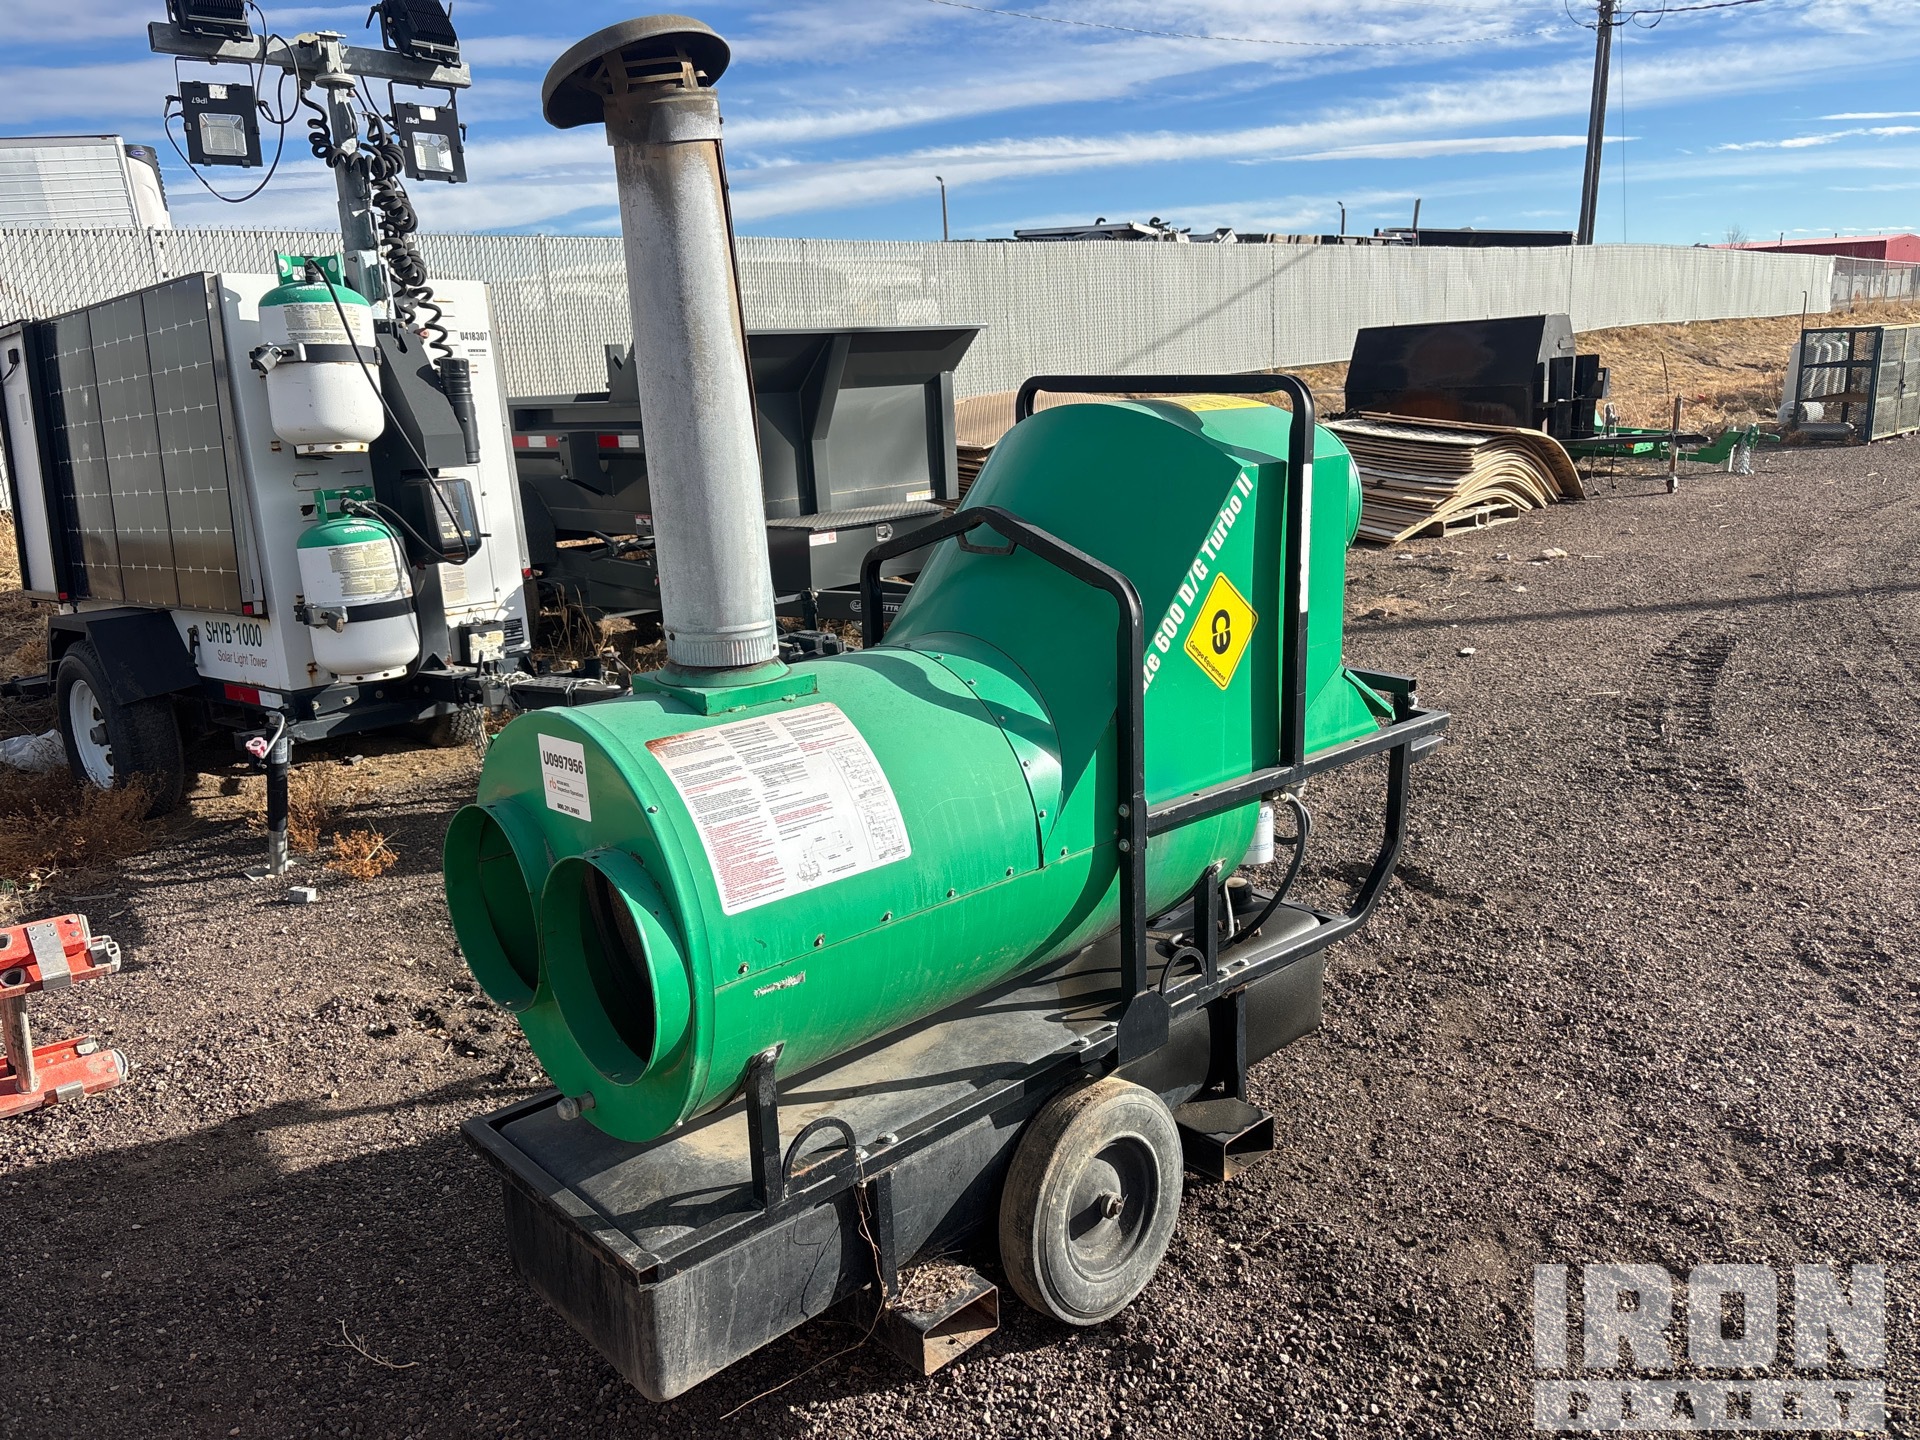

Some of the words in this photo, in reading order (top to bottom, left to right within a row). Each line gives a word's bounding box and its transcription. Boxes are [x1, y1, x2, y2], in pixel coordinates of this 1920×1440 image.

[191, 96, 208, 104] IP67
[405, 116, 420, 125] IP67
[1154, 602, 1185, 653] 600
[1178, 558, 1209, 607] D/G
[1200, 494, 1243, 561] Turbo
[205, 620, 262, 647] SHYB-1000
[217, 649, 233, 662] Solar
[233, 652, 249, 667] Light
[249, 654, 268, 668] Tower
[1189, 640, 1205, 659] Campo
[1203, 655, 1226, 682] Equipment
[542, 750, 584, 775] U0997956
